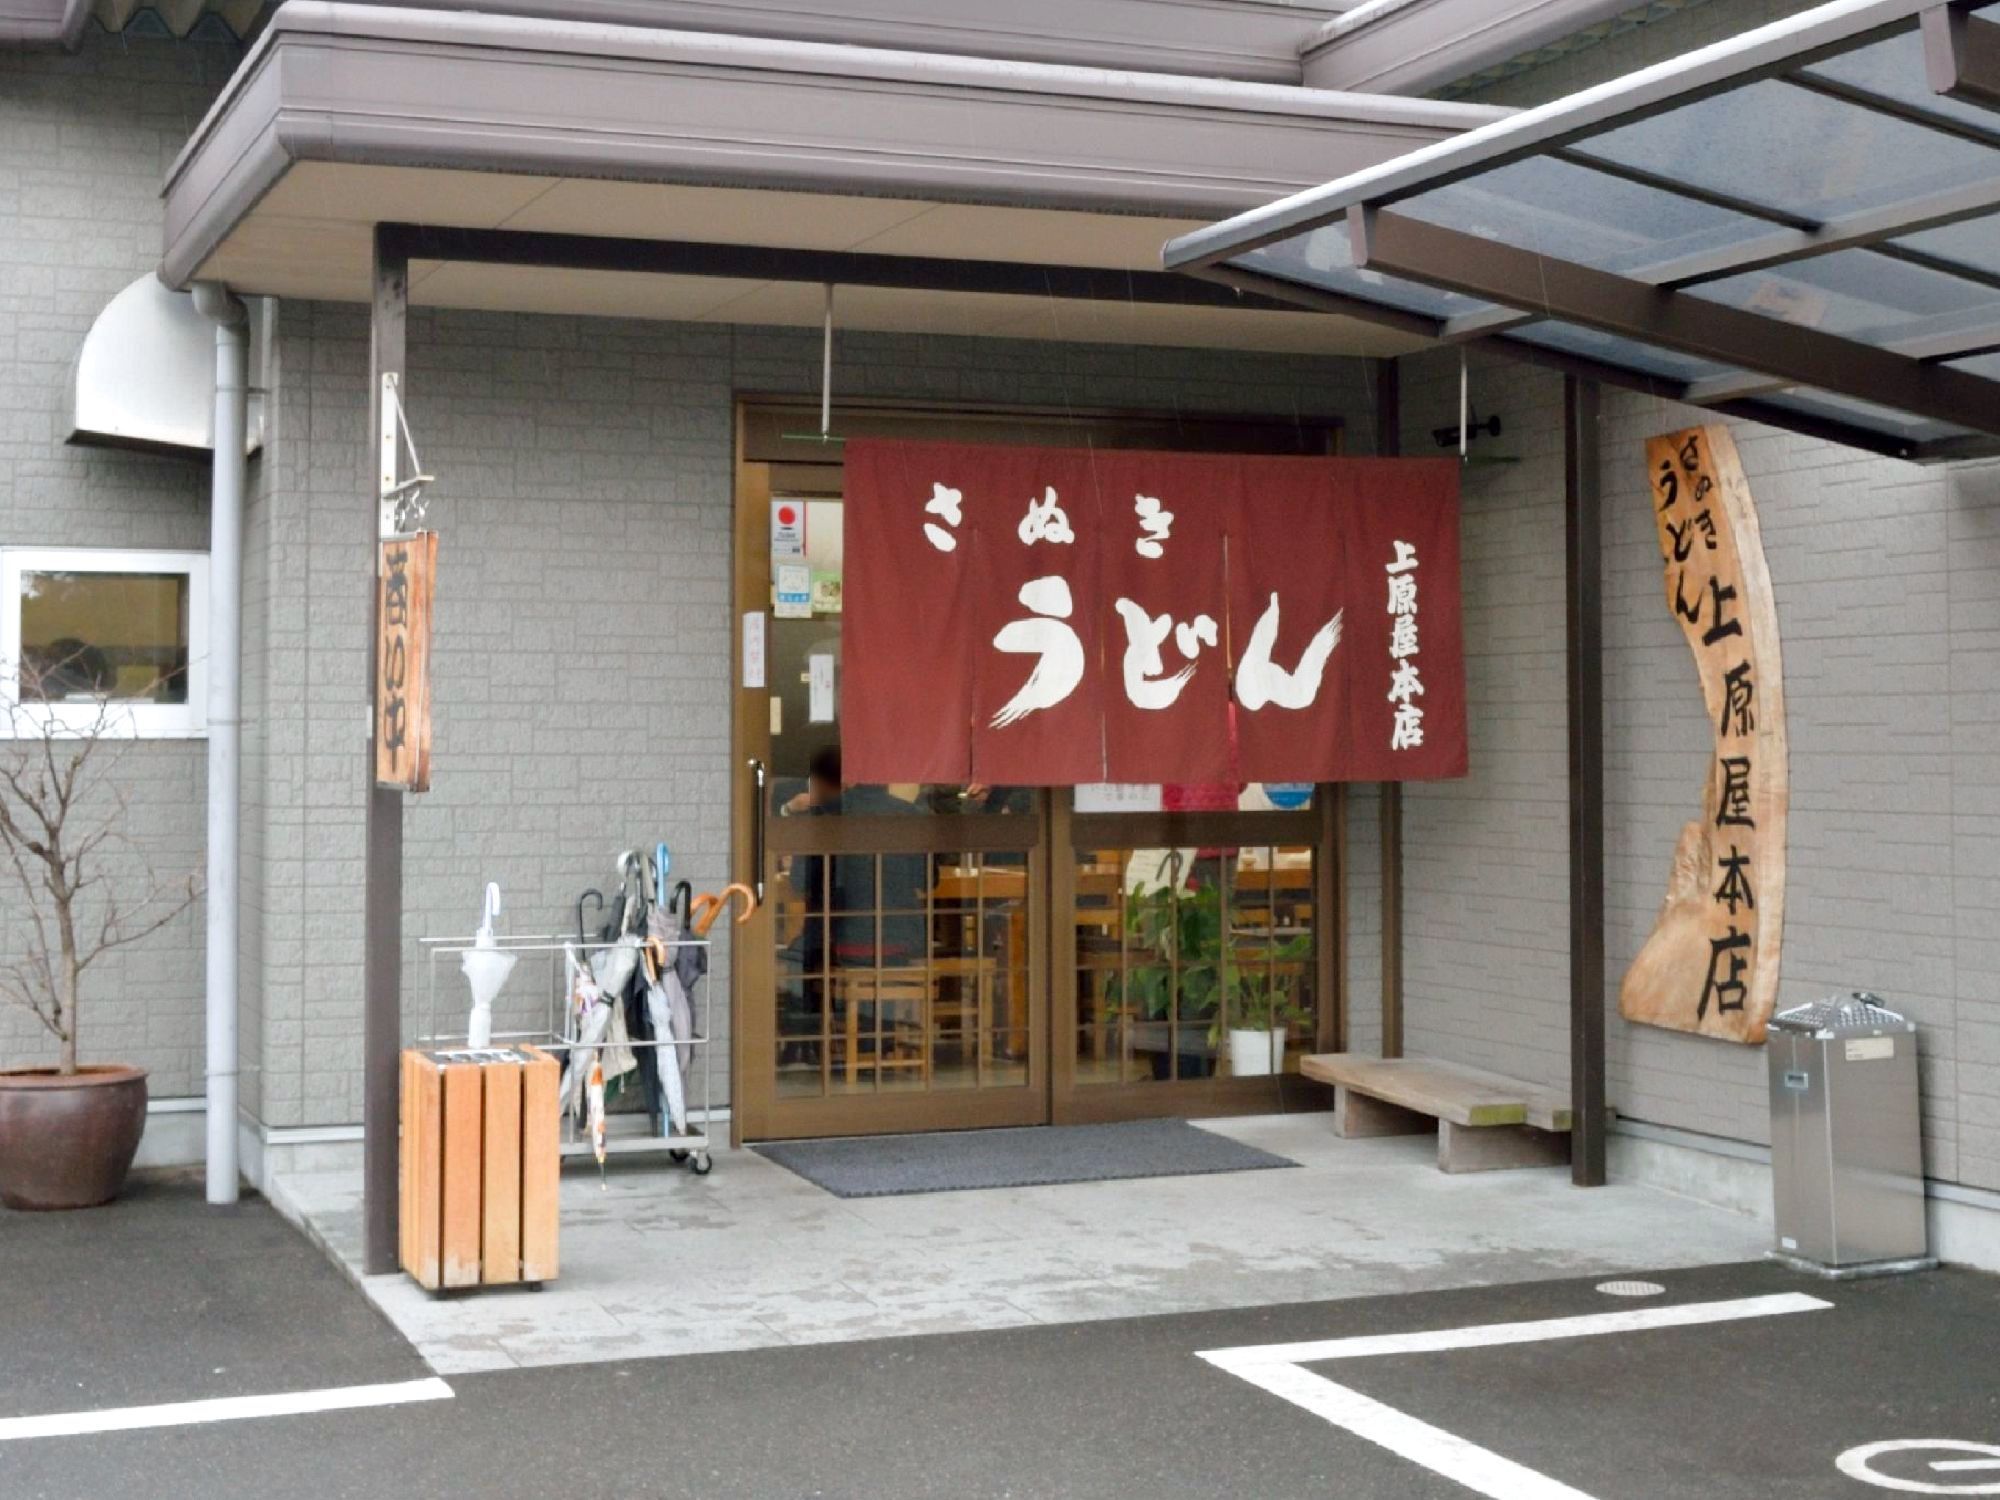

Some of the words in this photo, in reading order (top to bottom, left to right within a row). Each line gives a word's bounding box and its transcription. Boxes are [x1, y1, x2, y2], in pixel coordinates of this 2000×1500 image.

[924, 482, 1174, 559] さぬき
[1656, 458, 1704, 625] うどん
[989, 575, 1344, 730] うどん
[1385, 540, 1424, 751] 上原屋本店
[1697, 574, 1756, 1022] 上原屋本店
